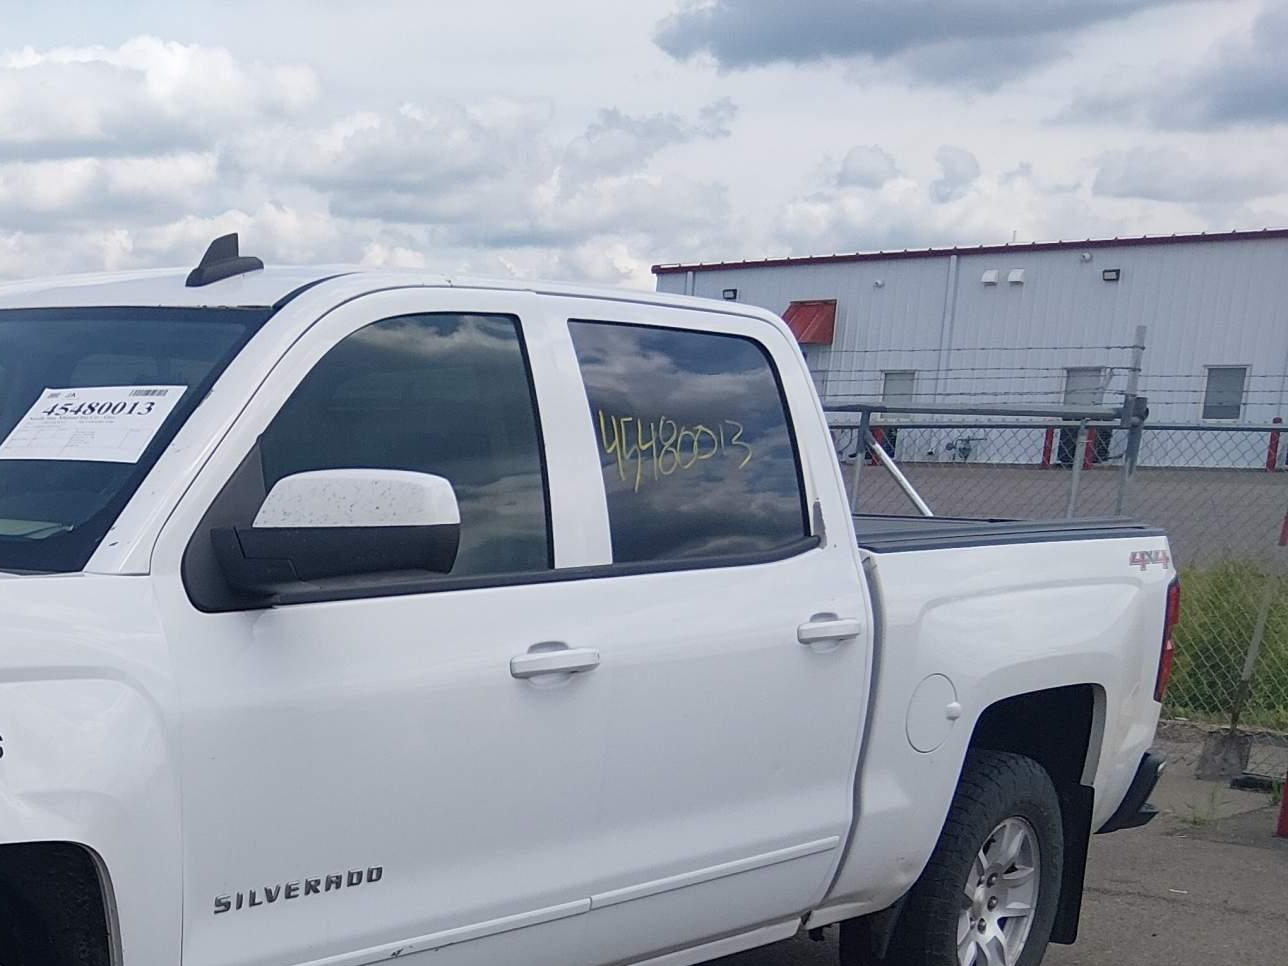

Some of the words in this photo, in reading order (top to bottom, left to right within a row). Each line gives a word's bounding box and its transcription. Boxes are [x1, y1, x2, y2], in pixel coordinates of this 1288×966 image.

[42, 400, 156, 416] 45480013
[599, 409, 752, 493] 45480013
[214, 865, 383, 915] SILVERADO
